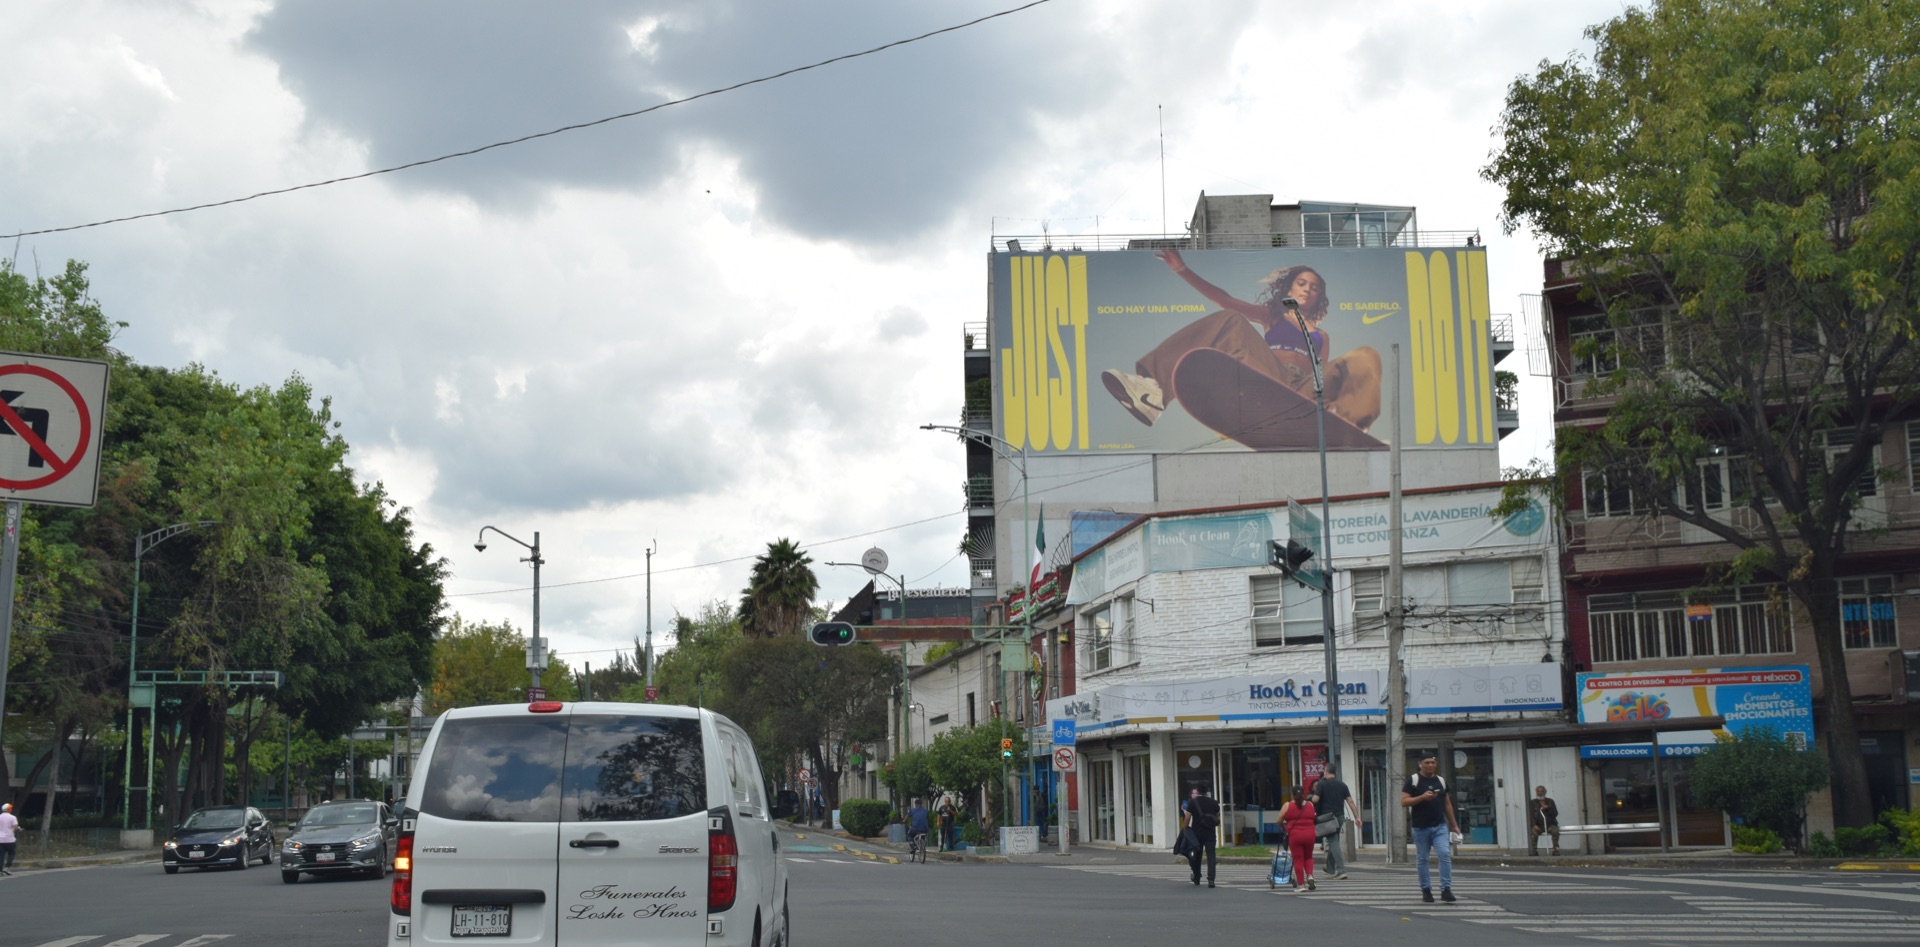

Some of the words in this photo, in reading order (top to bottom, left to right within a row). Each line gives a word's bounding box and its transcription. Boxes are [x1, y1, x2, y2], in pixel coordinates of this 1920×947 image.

[1097, 305, 1124, 314] SOLO
[1126, 305, 1145, 314] HAY
[1147, 305, 1168, 313] UNA
[1170, 304, 1206, 313] FORMA
[1340, 302, 1353, 311] DE
[1354, 302, 1402, 310] SABERLO.
[1002, 255, 1089, 451] JUST
[1405, 250, 1459, 445] DO
[1456, 250, 1493, 444] IT
[1322, 512, 1388, 530] TORERÍA
[1403, 503, 1493, 523] LAVANDERÍA
[1157, 529, 1188, 546] Hook
[1200, 530, 1230, 542] Clean
[1336, 533, 1354, 545] DE
[1357, 526, 1440, 543] CONANZA
[1843, 603, 1894, 621] NTISTA
[1632, 677, 1665, 686] DIVERSIÓN
[1752, 674, 1762, 682] DE
[1764, 672, 1797, 682] MÉXICO
[1249, 679, 1300, 701] Hook
[1318, 681, 1367, 696] Cean
[1743, 691, 1781, 703] Creando
[1248, 699, 1300, 710] TINTORERÍA
[1301, 700, 1309, 708] Y
[1310, 696, 1368, 707] LAVDERÍA
[1504, 696, 1556, 704] @HOOKNCLEAN
[1735, 699, 1795, 711] MOMENTOS
[1725, 707, 1809, 720] EMOCIONANTES
[1590, 748, 1649, 756] ELROLLO.COM.MX
[422, 845, 458, 854] HYUNDAI
[658, 845, 700, 854] Starex
[579, 884, 687, 900] Funerales
[633, 903, 699, 919] Hnos
[454, 913, 509, 927] LH-11-810
[470, 926, 508, 936] Azcapotzalco
